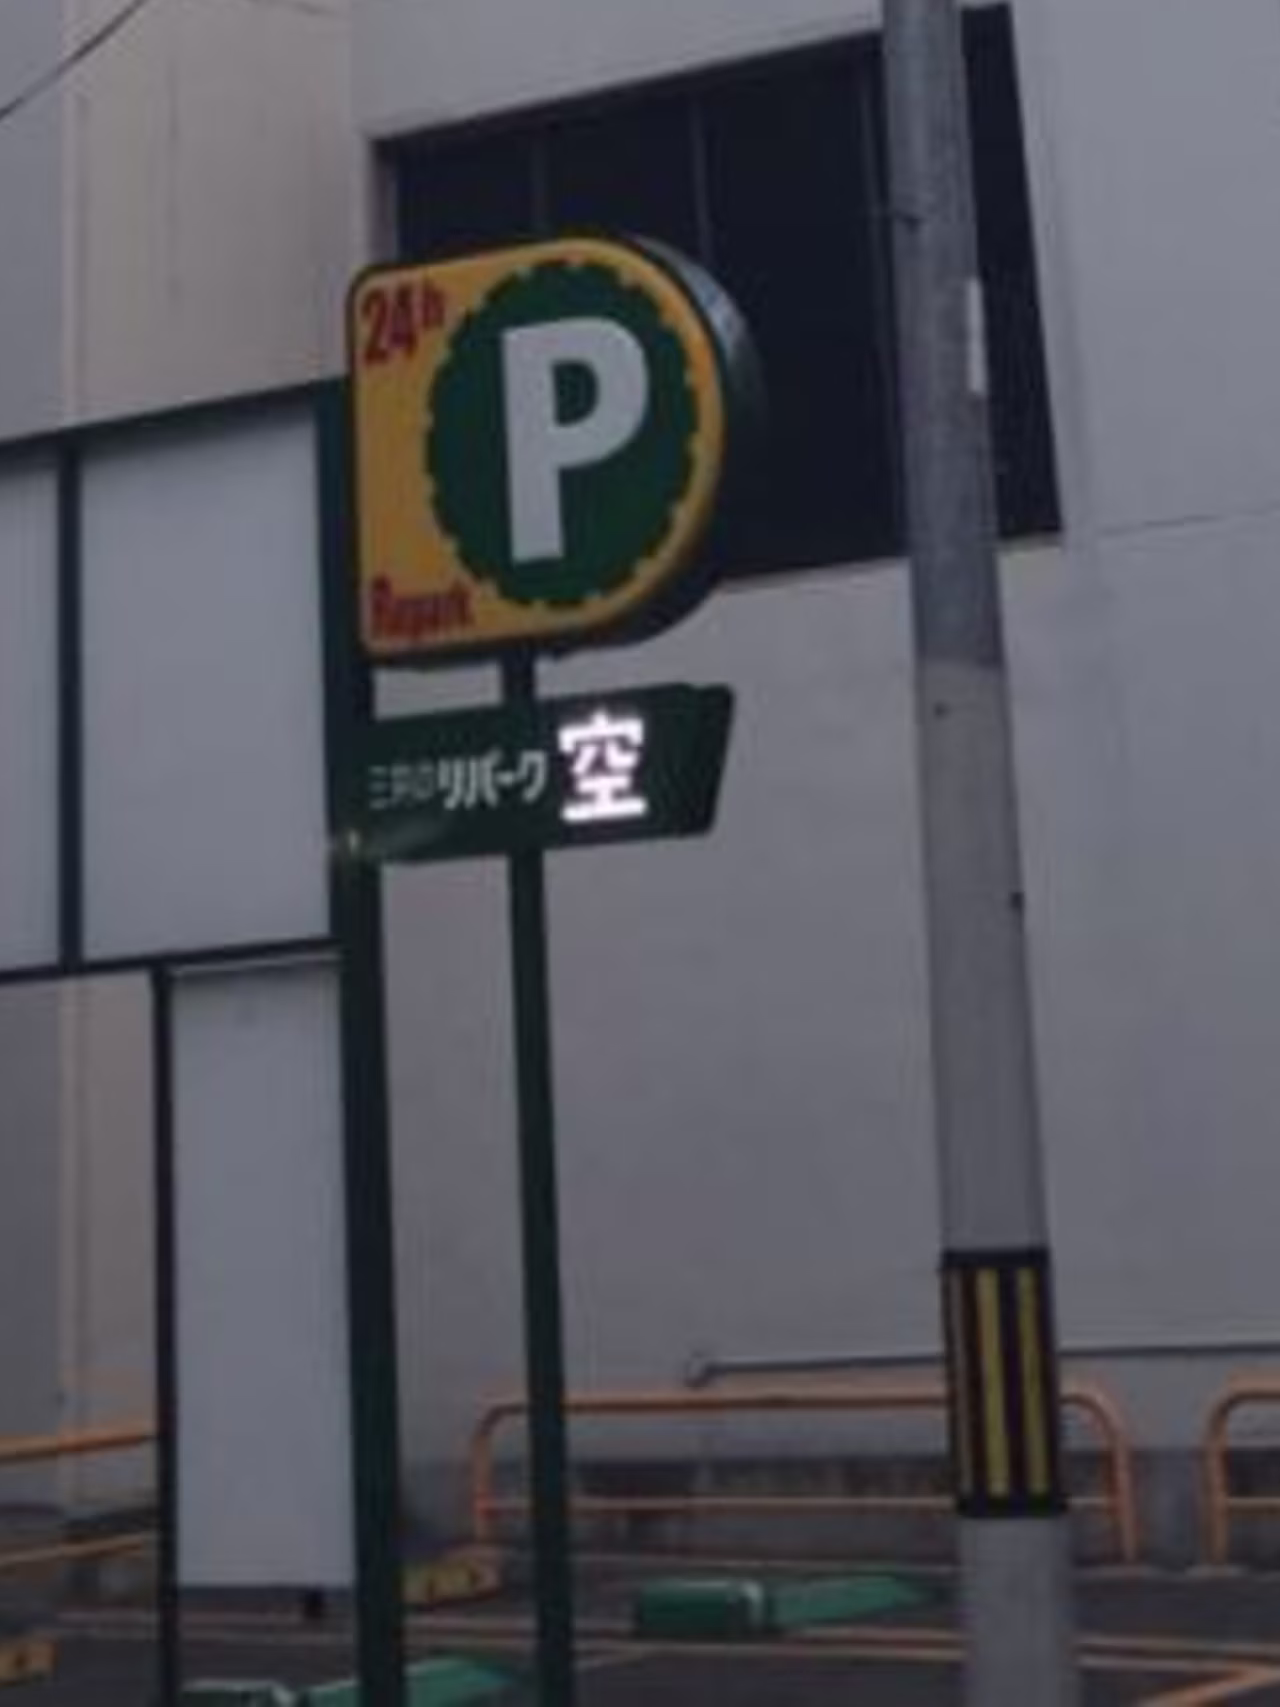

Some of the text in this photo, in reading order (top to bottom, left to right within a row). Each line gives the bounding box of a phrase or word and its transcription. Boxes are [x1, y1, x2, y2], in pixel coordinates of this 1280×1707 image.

[361, 279, 447, 364] 24h
[500, 316, 650, 565] P
[557, 709, 649, 823] 空
